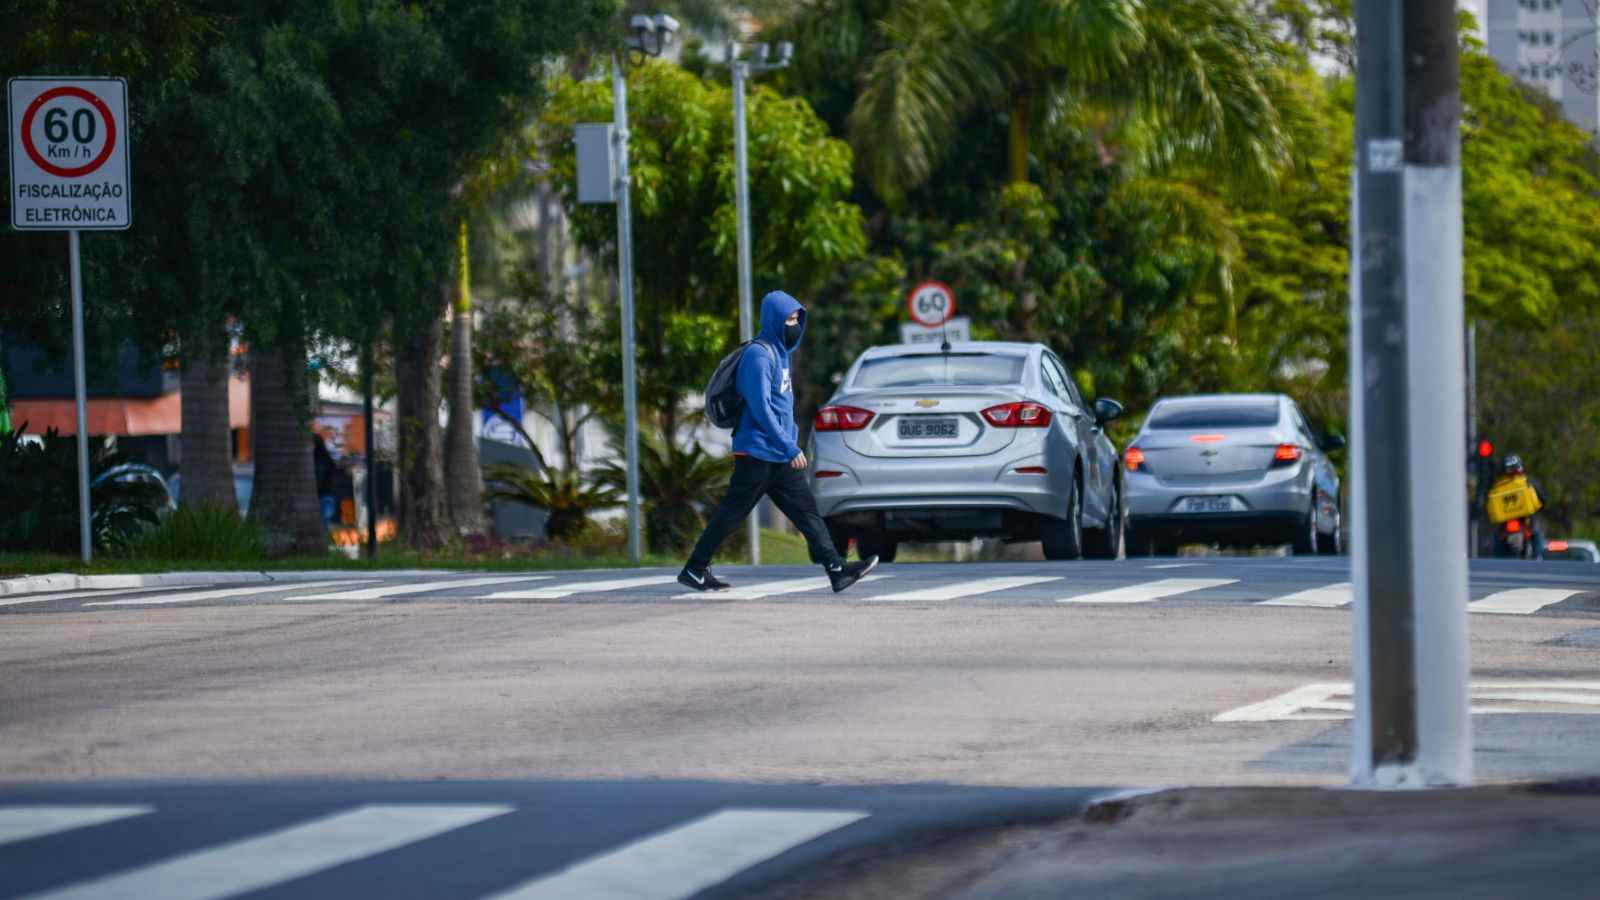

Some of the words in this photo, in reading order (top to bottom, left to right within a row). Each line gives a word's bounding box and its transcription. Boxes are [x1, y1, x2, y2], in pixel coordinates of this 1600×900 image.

[44, 107, 96, 144] 60
[19, 182, 122, 201] FISCALIZAÇÃO
[25, 204, 116, 221] ELETRÔNICA
[918, 291, 946, 313] 60
